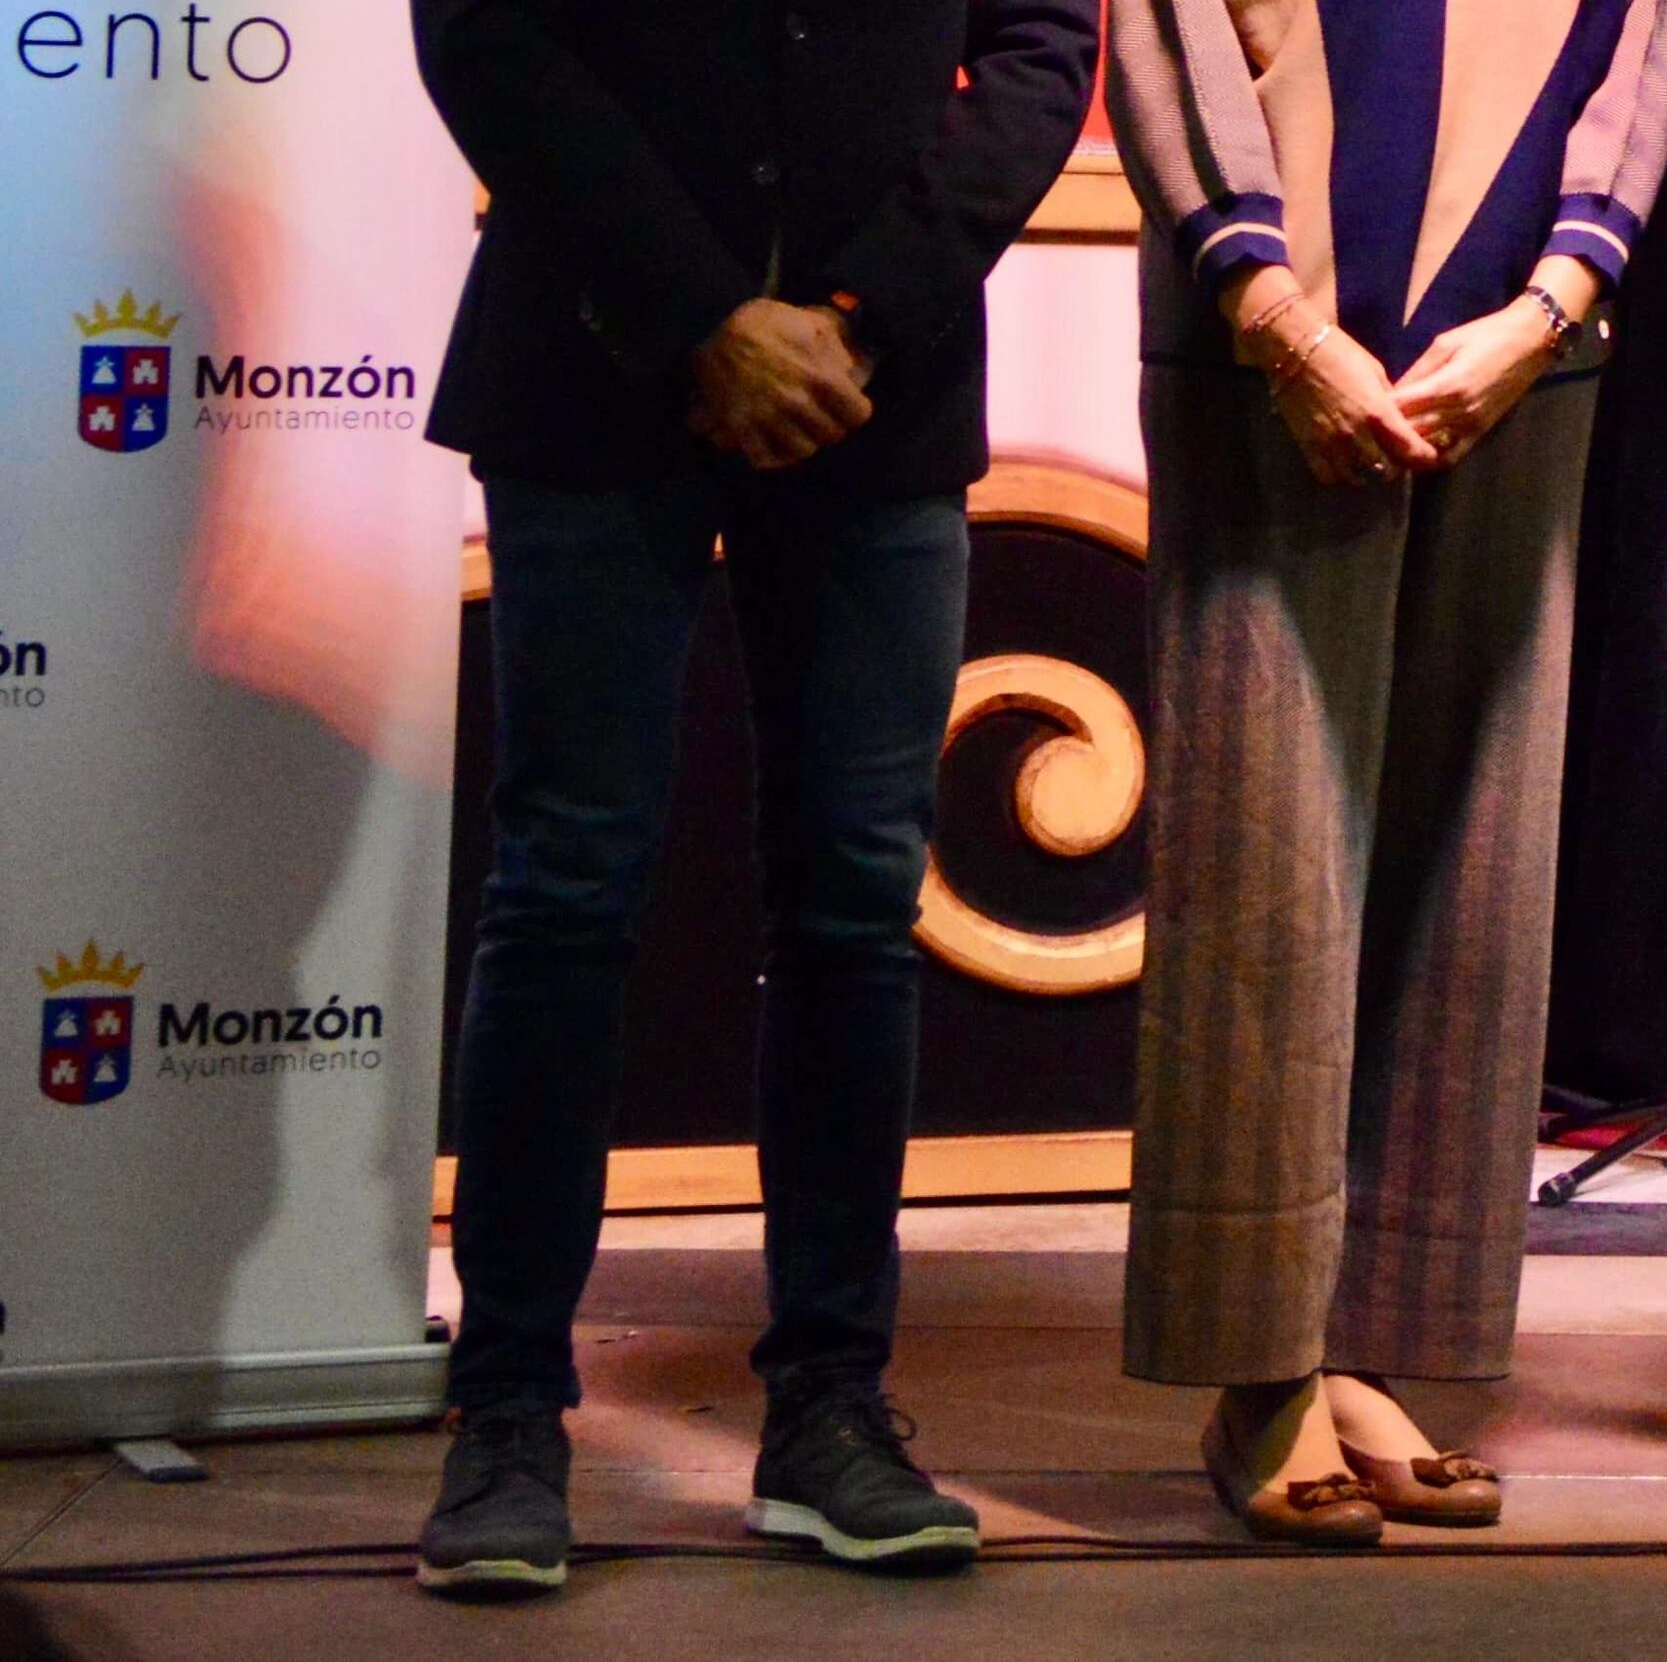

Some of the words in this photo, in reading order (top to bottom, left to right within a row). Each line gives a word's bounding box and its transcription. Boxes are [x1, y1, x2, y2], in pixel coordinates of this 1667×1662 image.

[195, 354, 415, 399] Monzón
[194, 405, 415, 435] Ayuntamiento
[157, 995, 383, 1048] Monzón
[156, 1049, 383, 1082] Ayuntamiento
